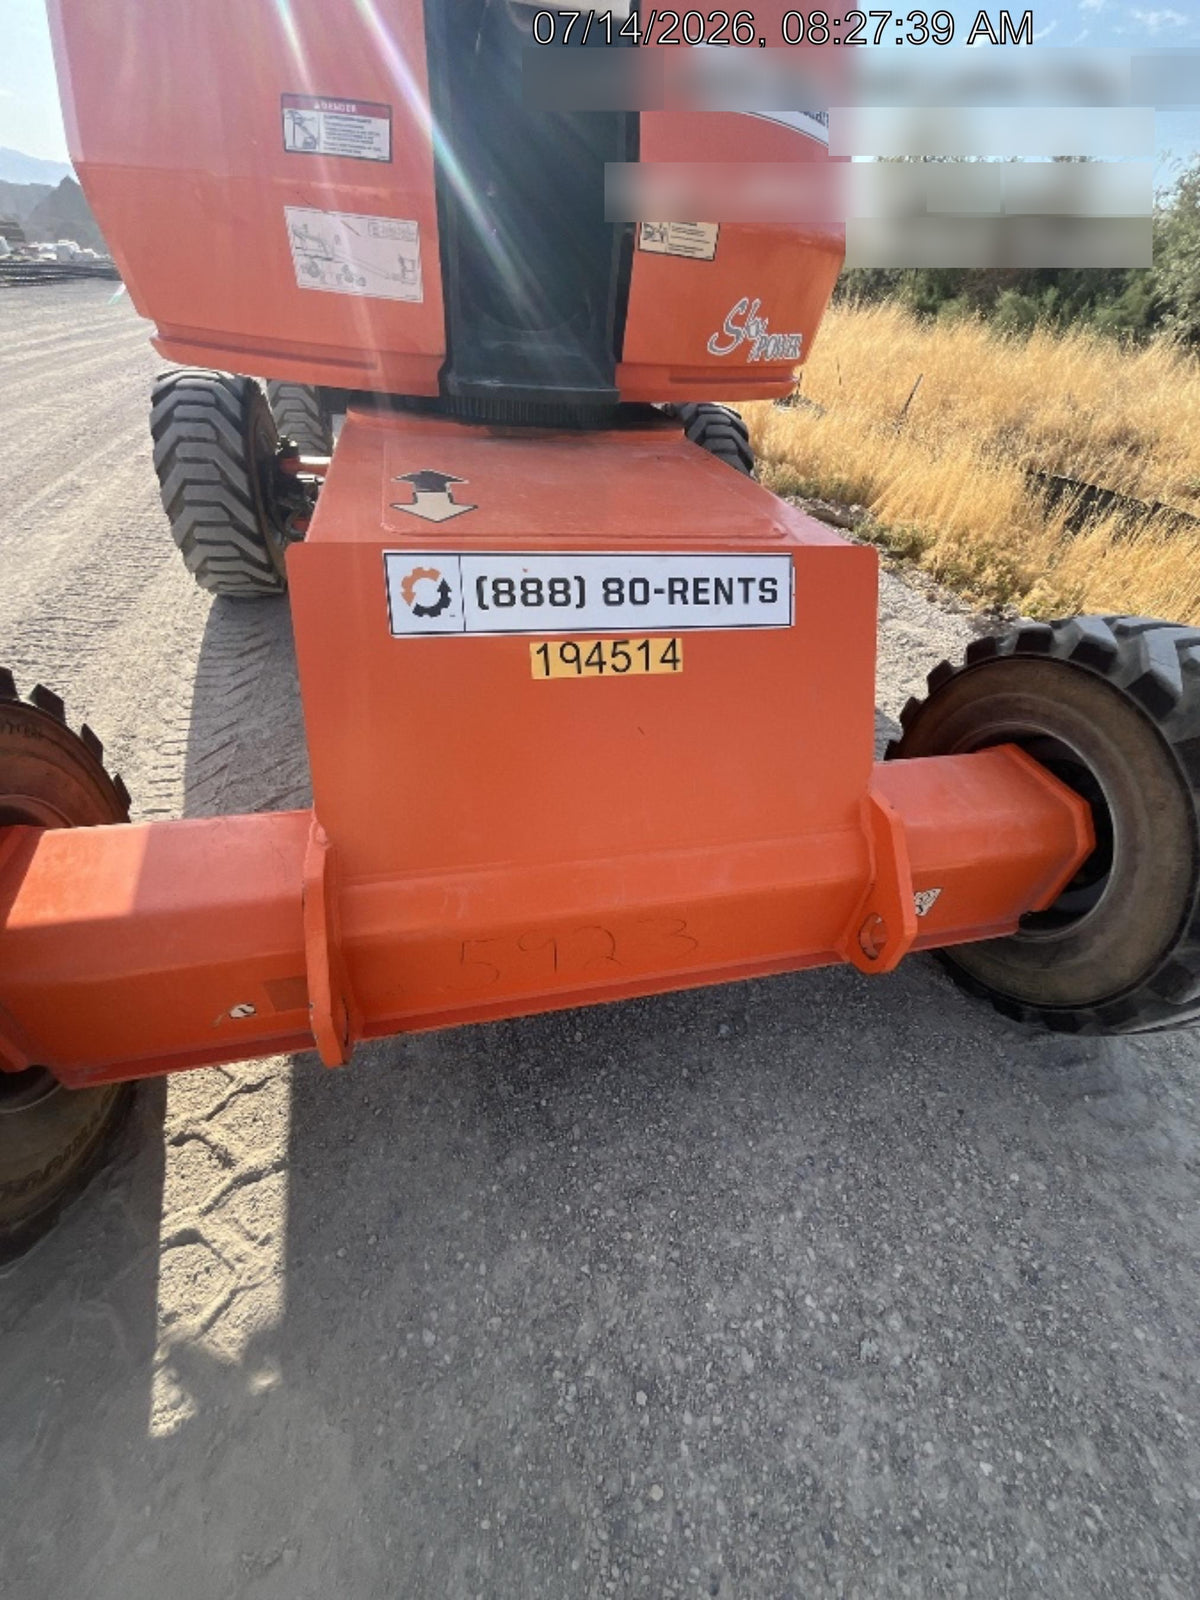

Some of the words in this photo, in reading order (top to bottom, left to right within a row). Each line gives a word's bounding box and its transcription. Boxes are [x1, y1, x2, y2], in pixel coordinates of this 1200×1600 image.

[475, 575, 587, 610] (888)
[601, 576, 779, 606] 80-RENTS
[535, 638, 682, 676] 194514
